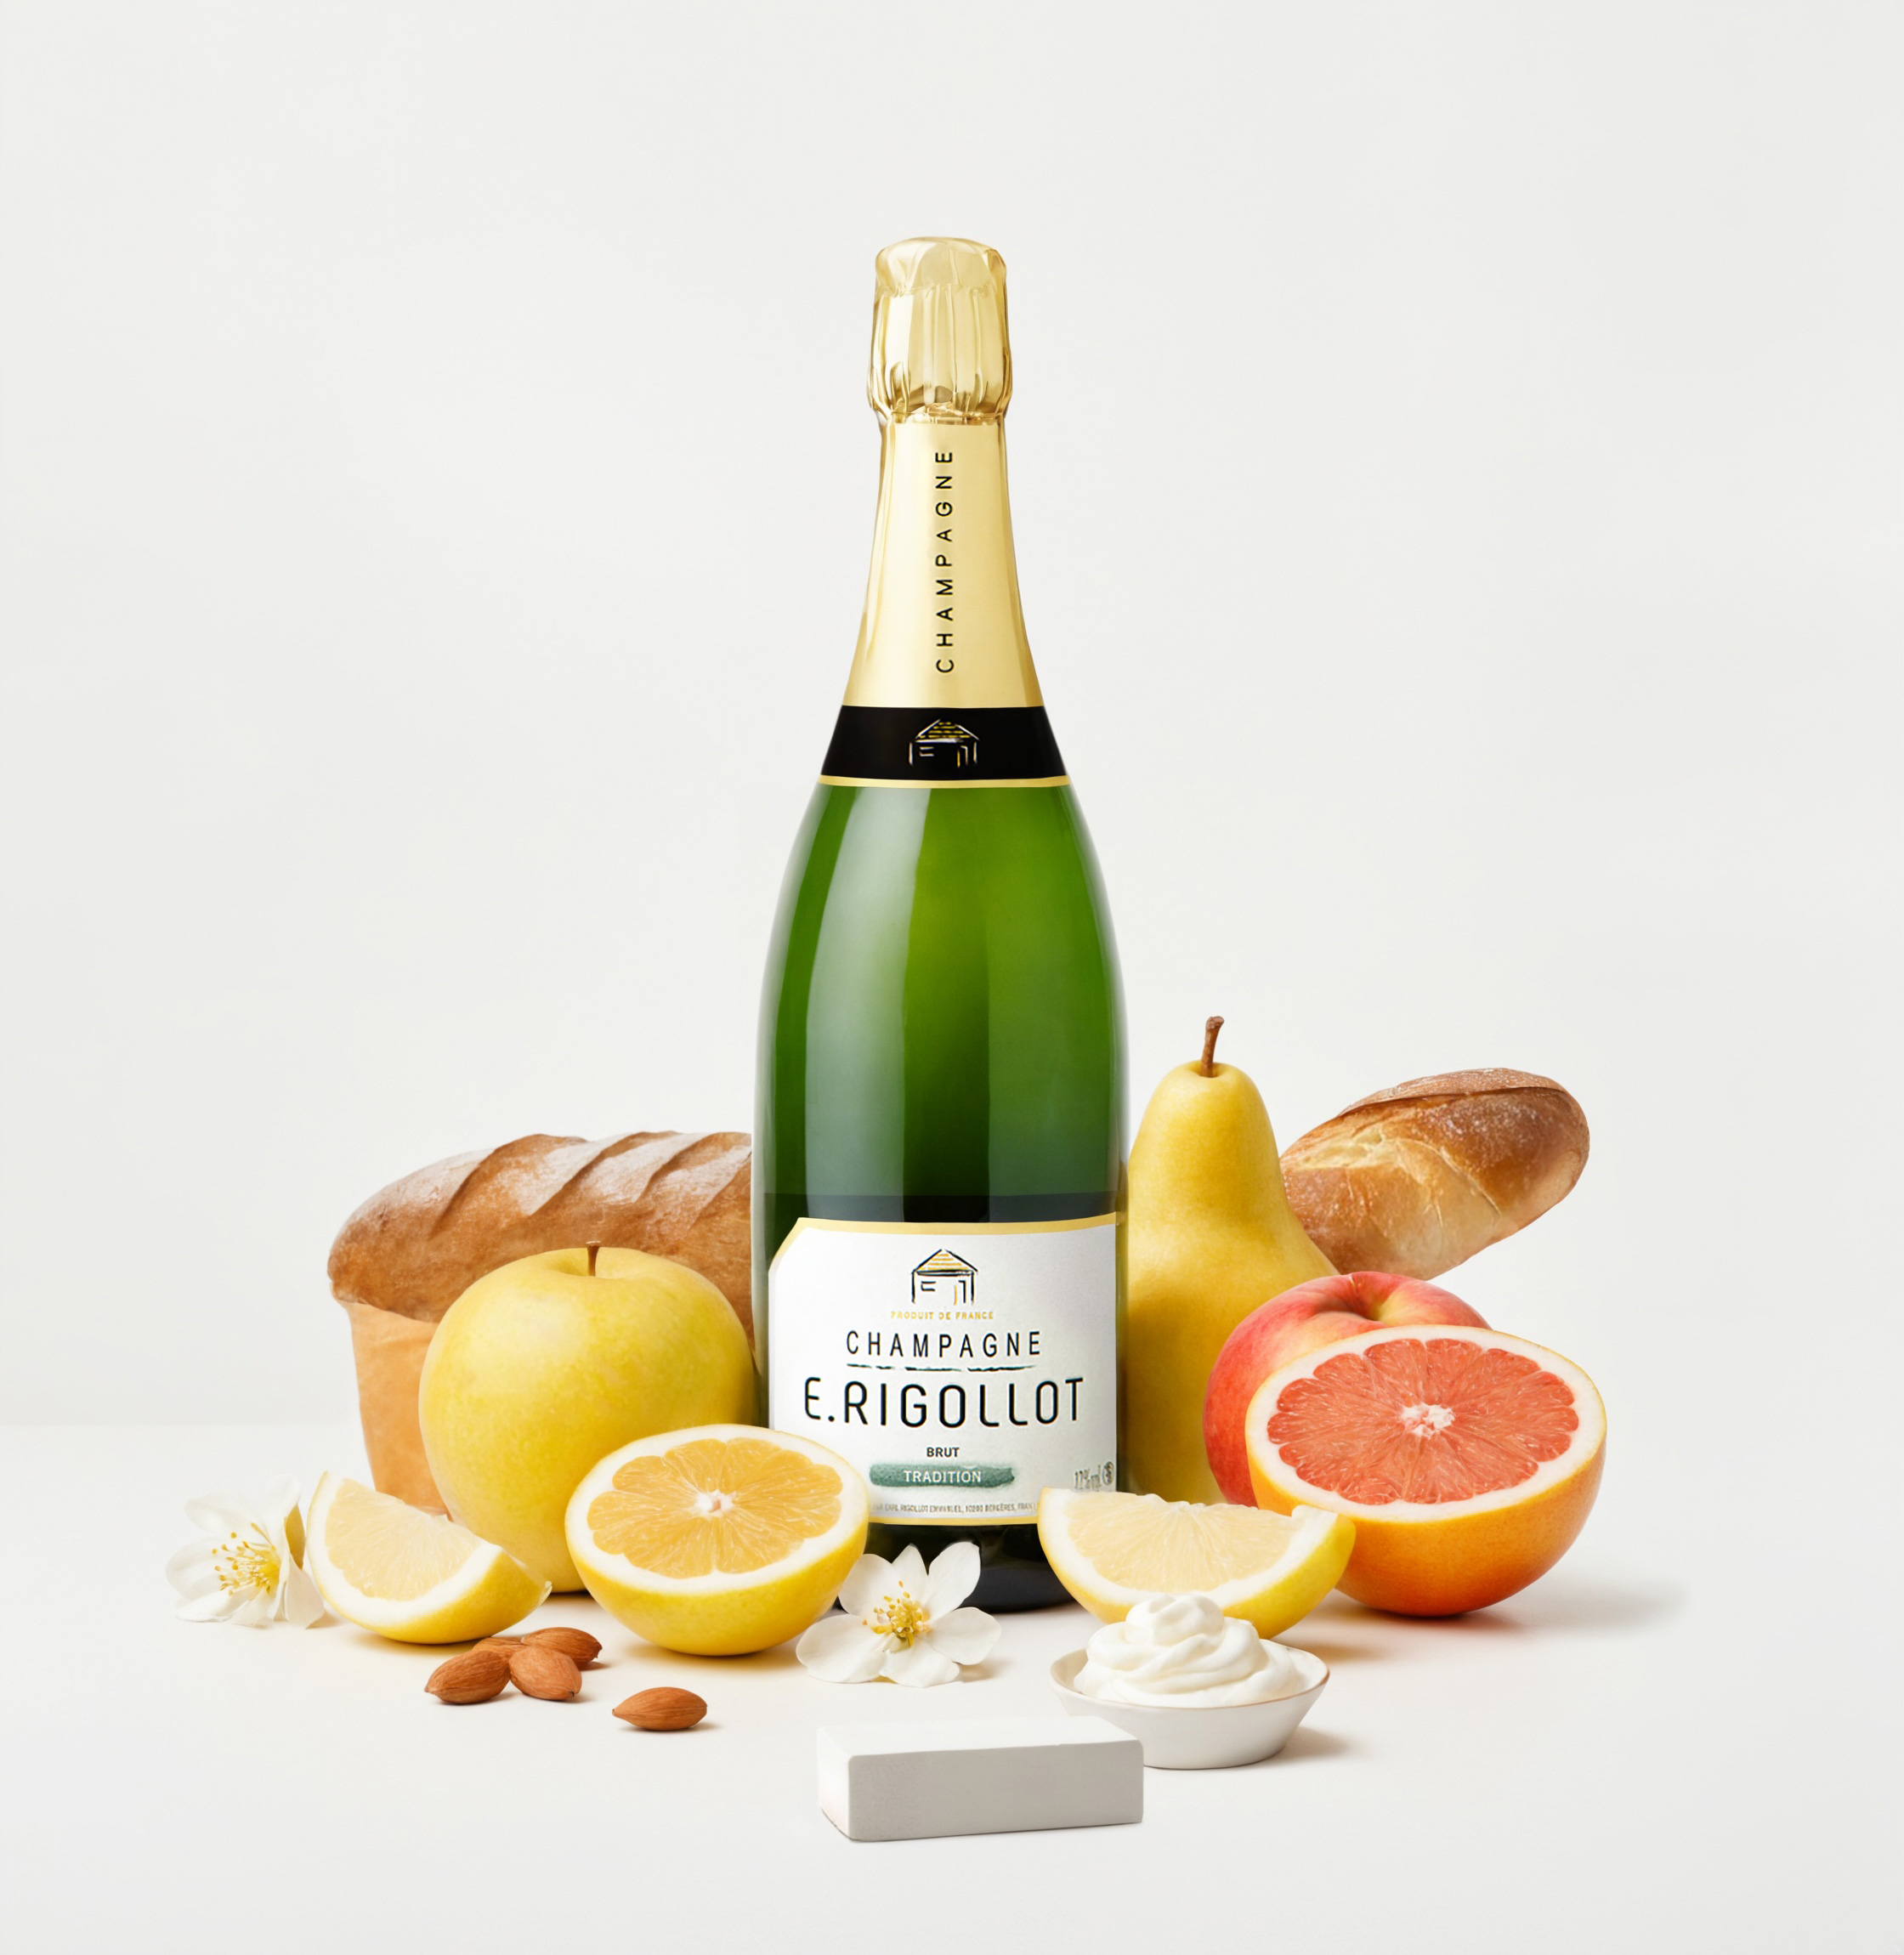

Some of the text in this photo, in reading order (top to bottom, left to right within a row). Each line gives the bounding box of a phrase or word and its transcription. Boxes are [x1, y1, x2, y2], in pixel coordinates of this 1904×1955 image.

[934, 450, 955, 674] CHAMPAGNE
[890, 1310, 994, 1320] PRODUIT DE FRANCE
[846, 1329, 1042, 1358] CHAMPAGNE
[803, 1376, 1085, 1429] E.RIGOLLOT
[926, 1446, 960, 1459] BRUT
[904, 1469, 982, 1484] TRADITION
